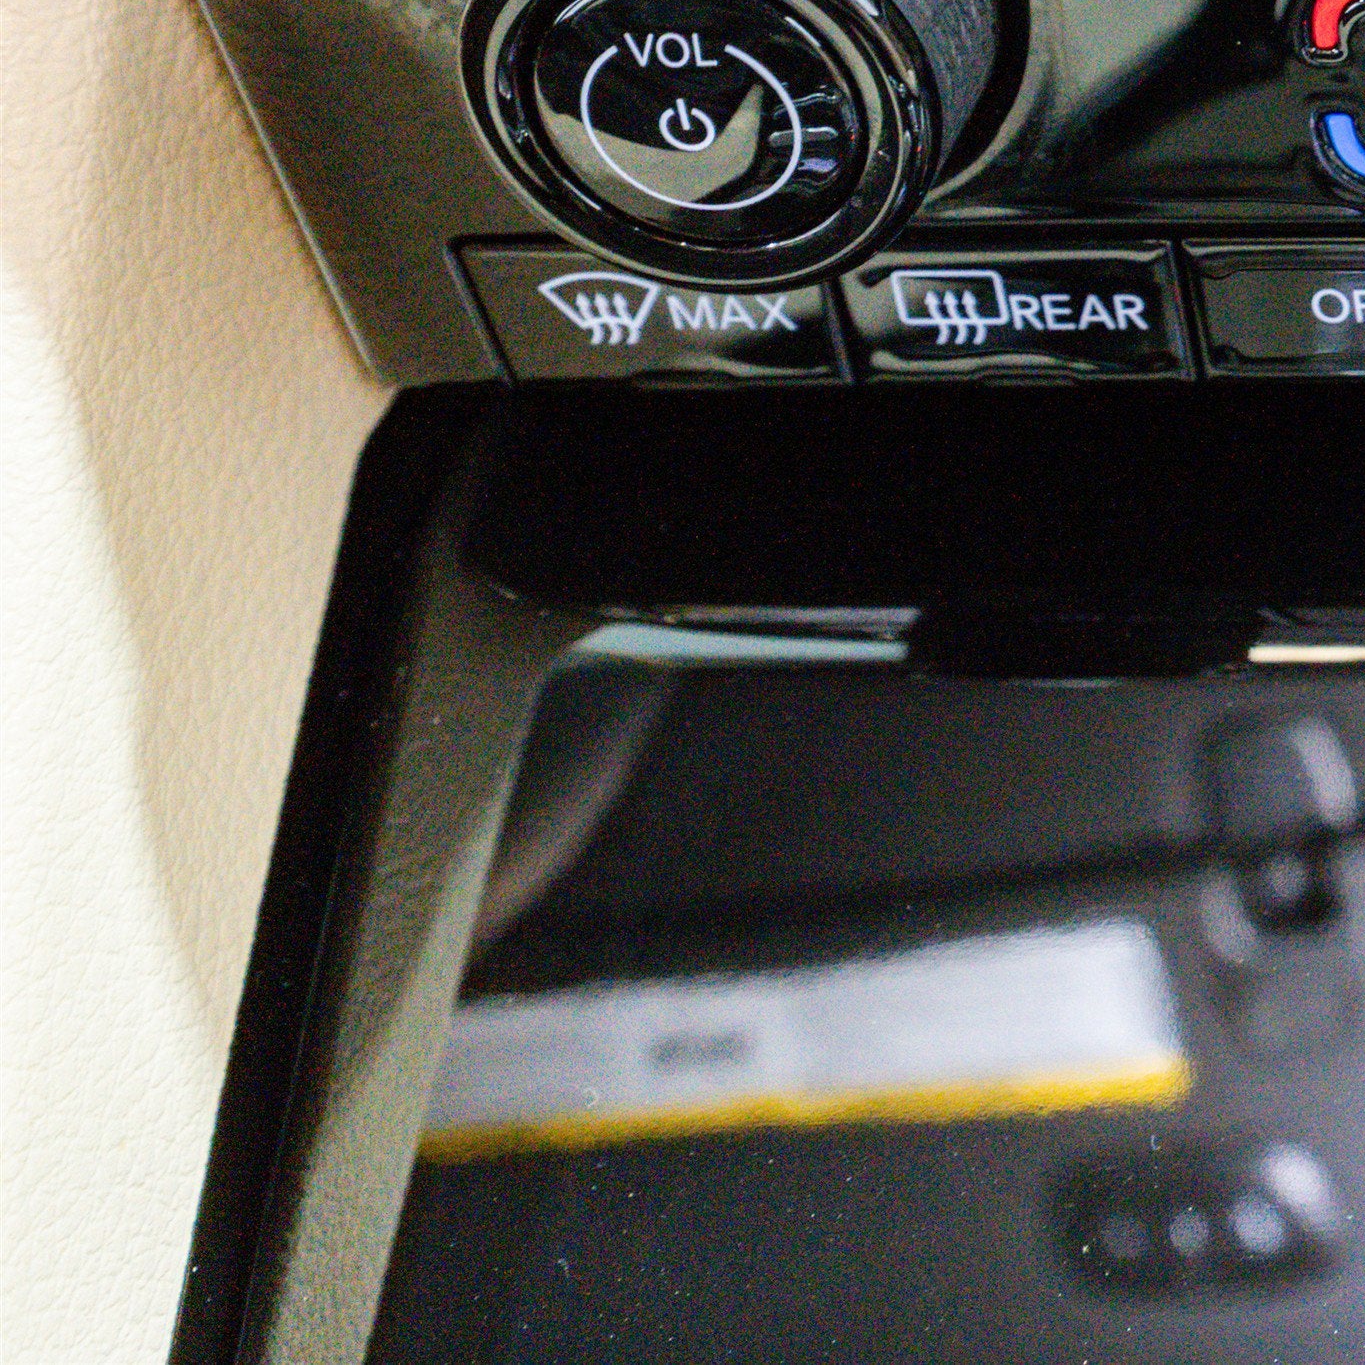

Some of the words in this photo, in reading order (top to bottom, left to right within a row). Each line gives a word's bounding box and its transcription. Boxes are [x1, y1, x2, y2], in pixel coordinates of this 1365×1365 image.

[623, 32, 719, 69] VOL
[666, 294, 796, 330] MAX
[1010, 294, 1148, 330] REAR
